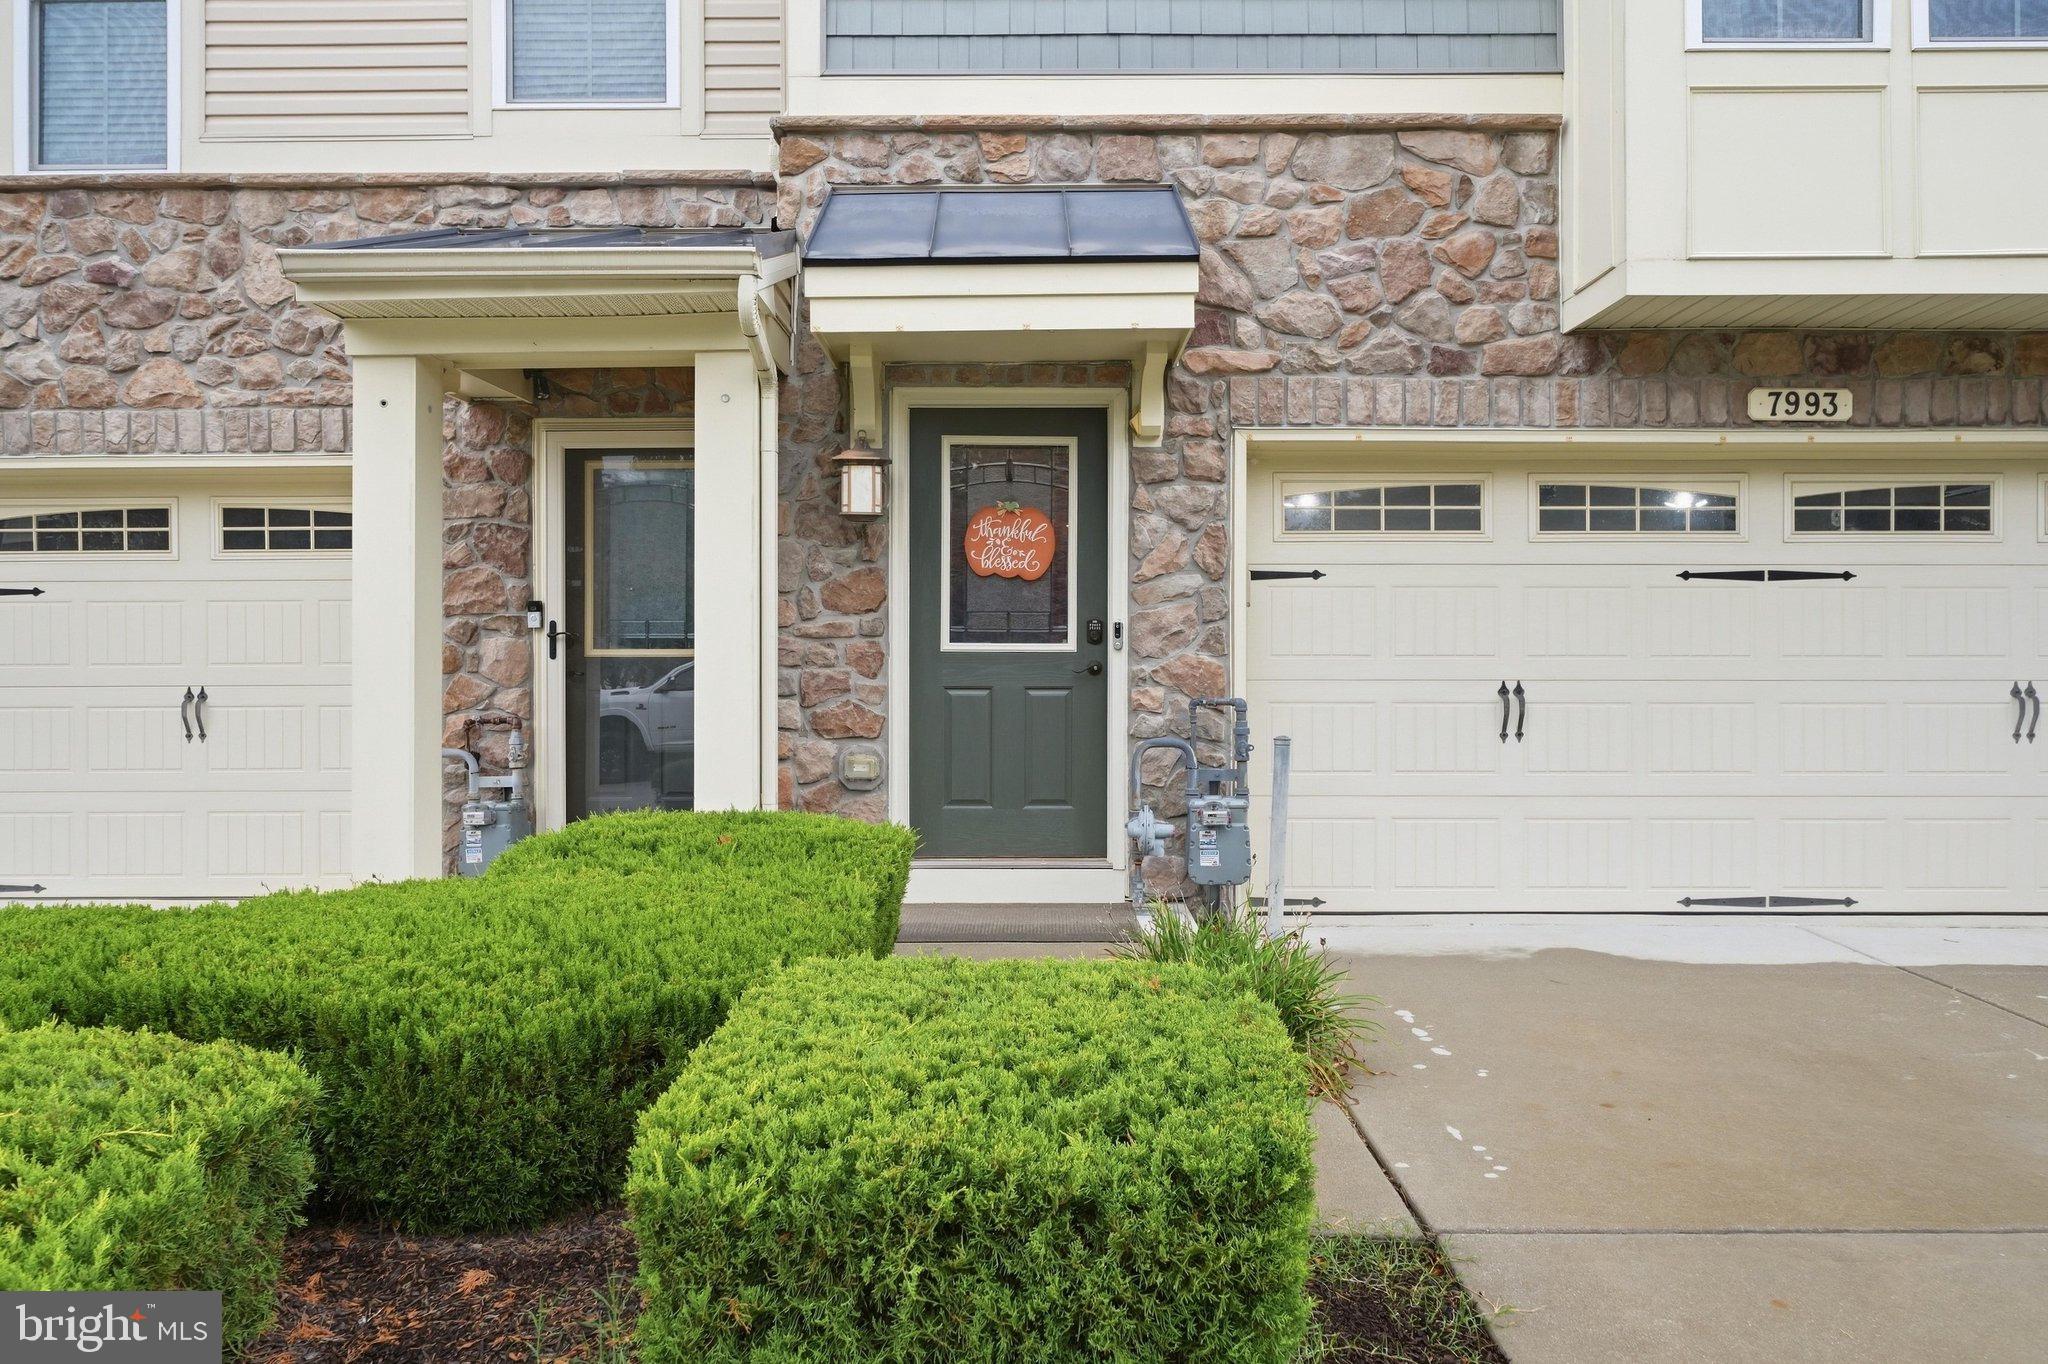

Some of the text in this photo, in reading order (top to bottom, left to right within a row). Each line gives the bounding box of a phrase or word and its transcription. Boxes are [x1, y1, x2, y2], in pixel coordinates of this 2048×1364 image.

[1767, 391, 1838, 417] 7993
[971, 516, 1047, 543] thankful
[971, 545, 1040, 572] blessed
